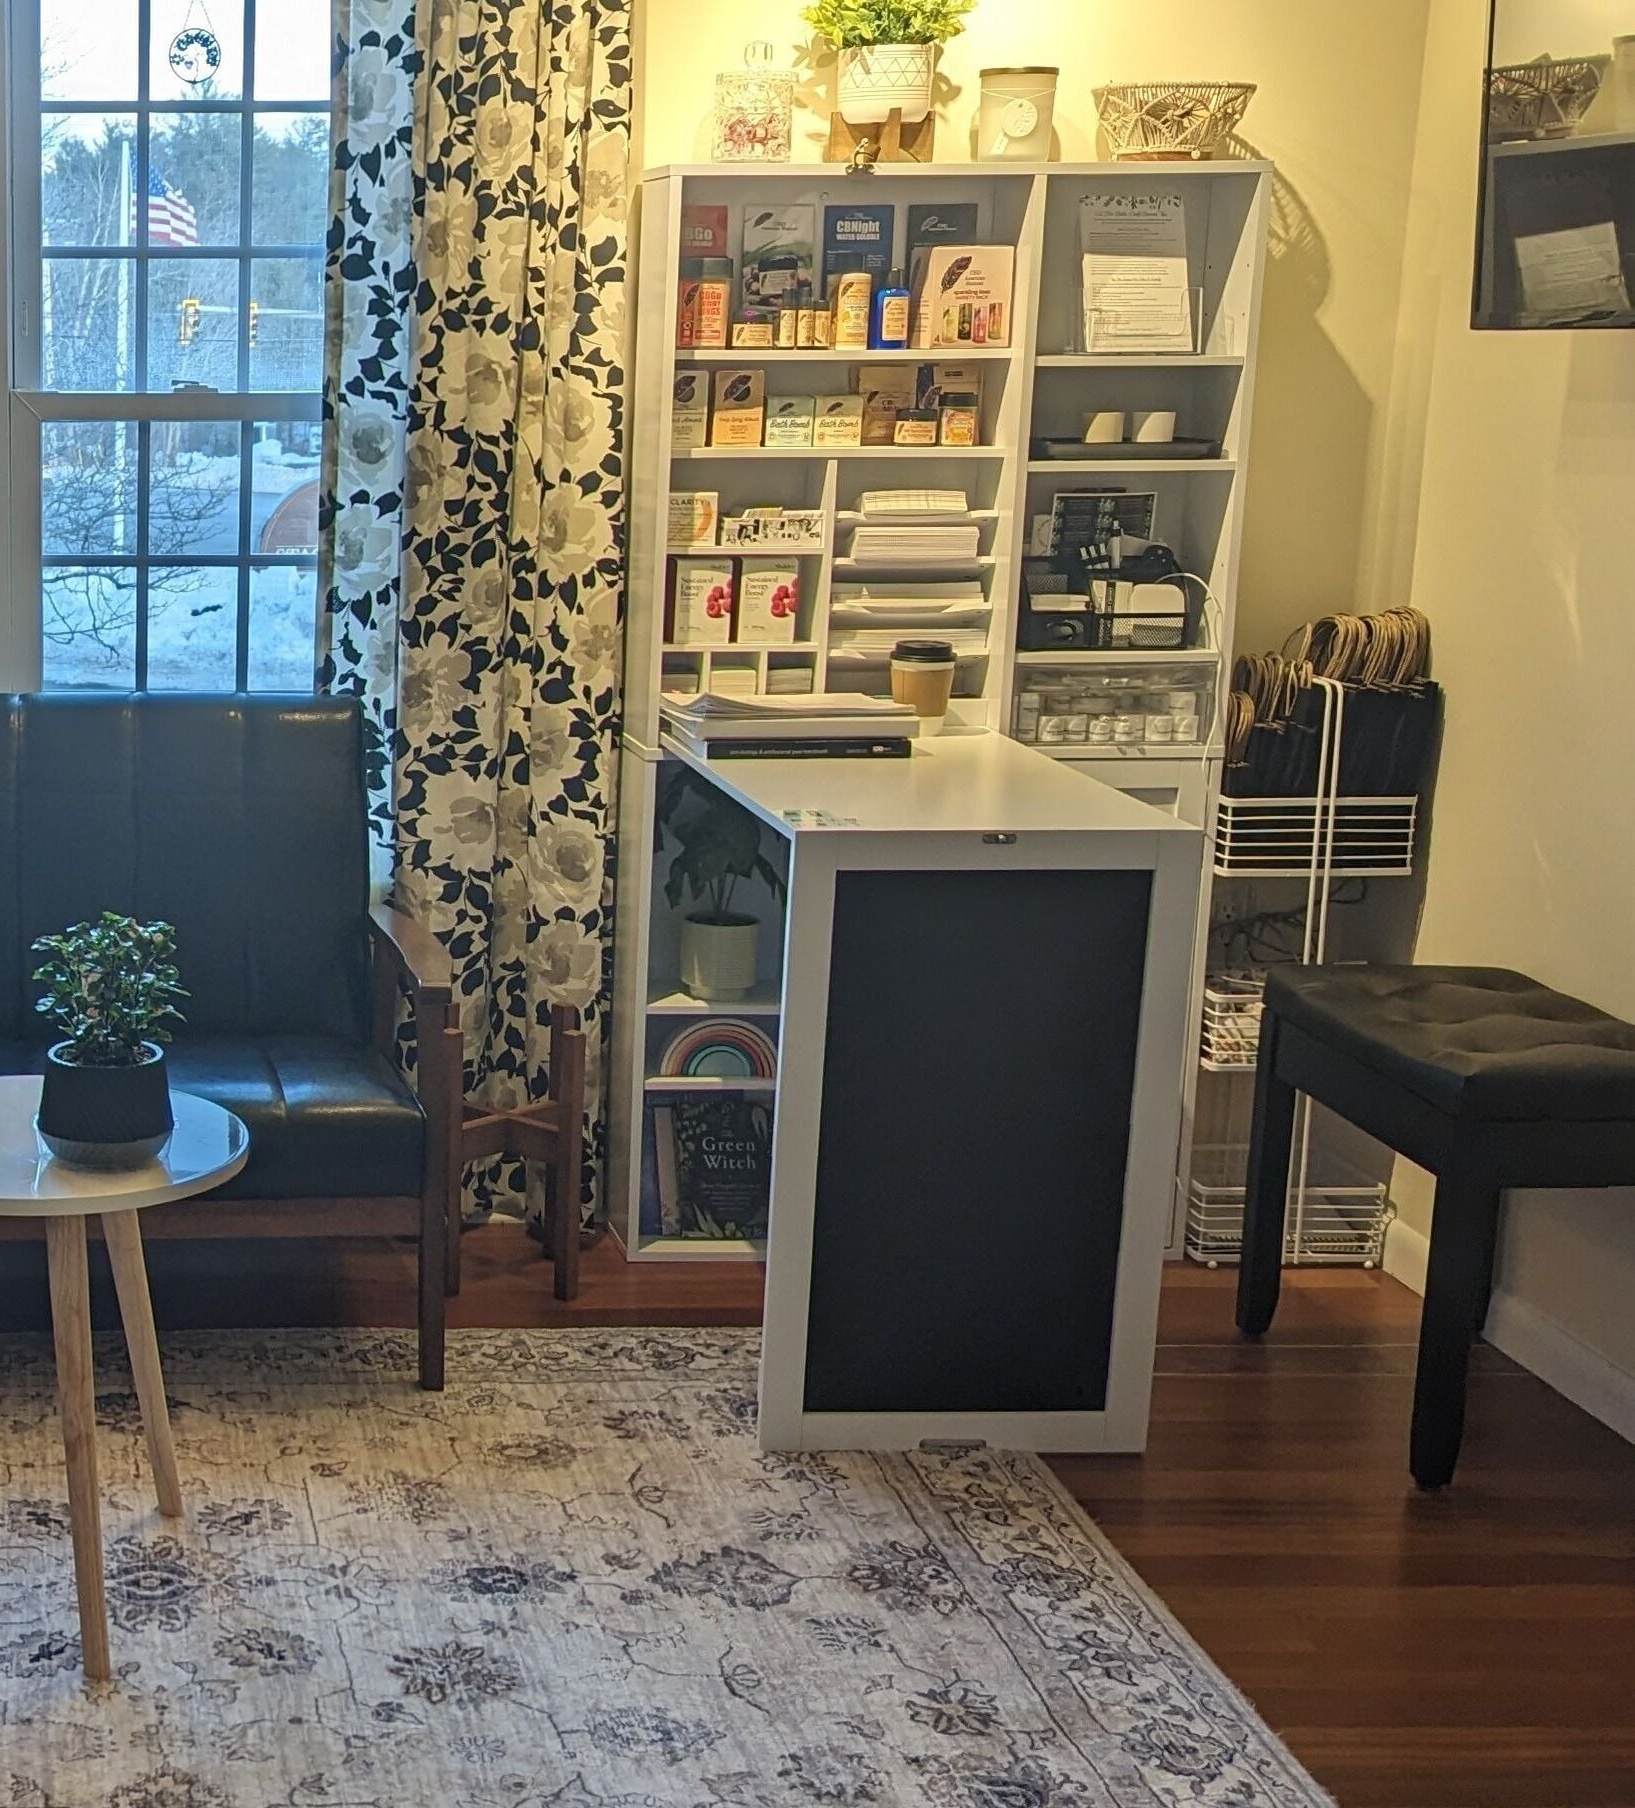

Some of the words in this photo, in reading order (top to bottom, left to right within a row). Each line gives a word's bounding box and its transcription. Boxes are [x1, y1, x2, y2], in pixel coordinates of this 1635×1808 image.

[683, 227, 712, 240] BGo
[836, 220, 880, 233] CBNight
[702, 1136, 756, 1152] Green
[703, 1154, 757, 1169] Witch
